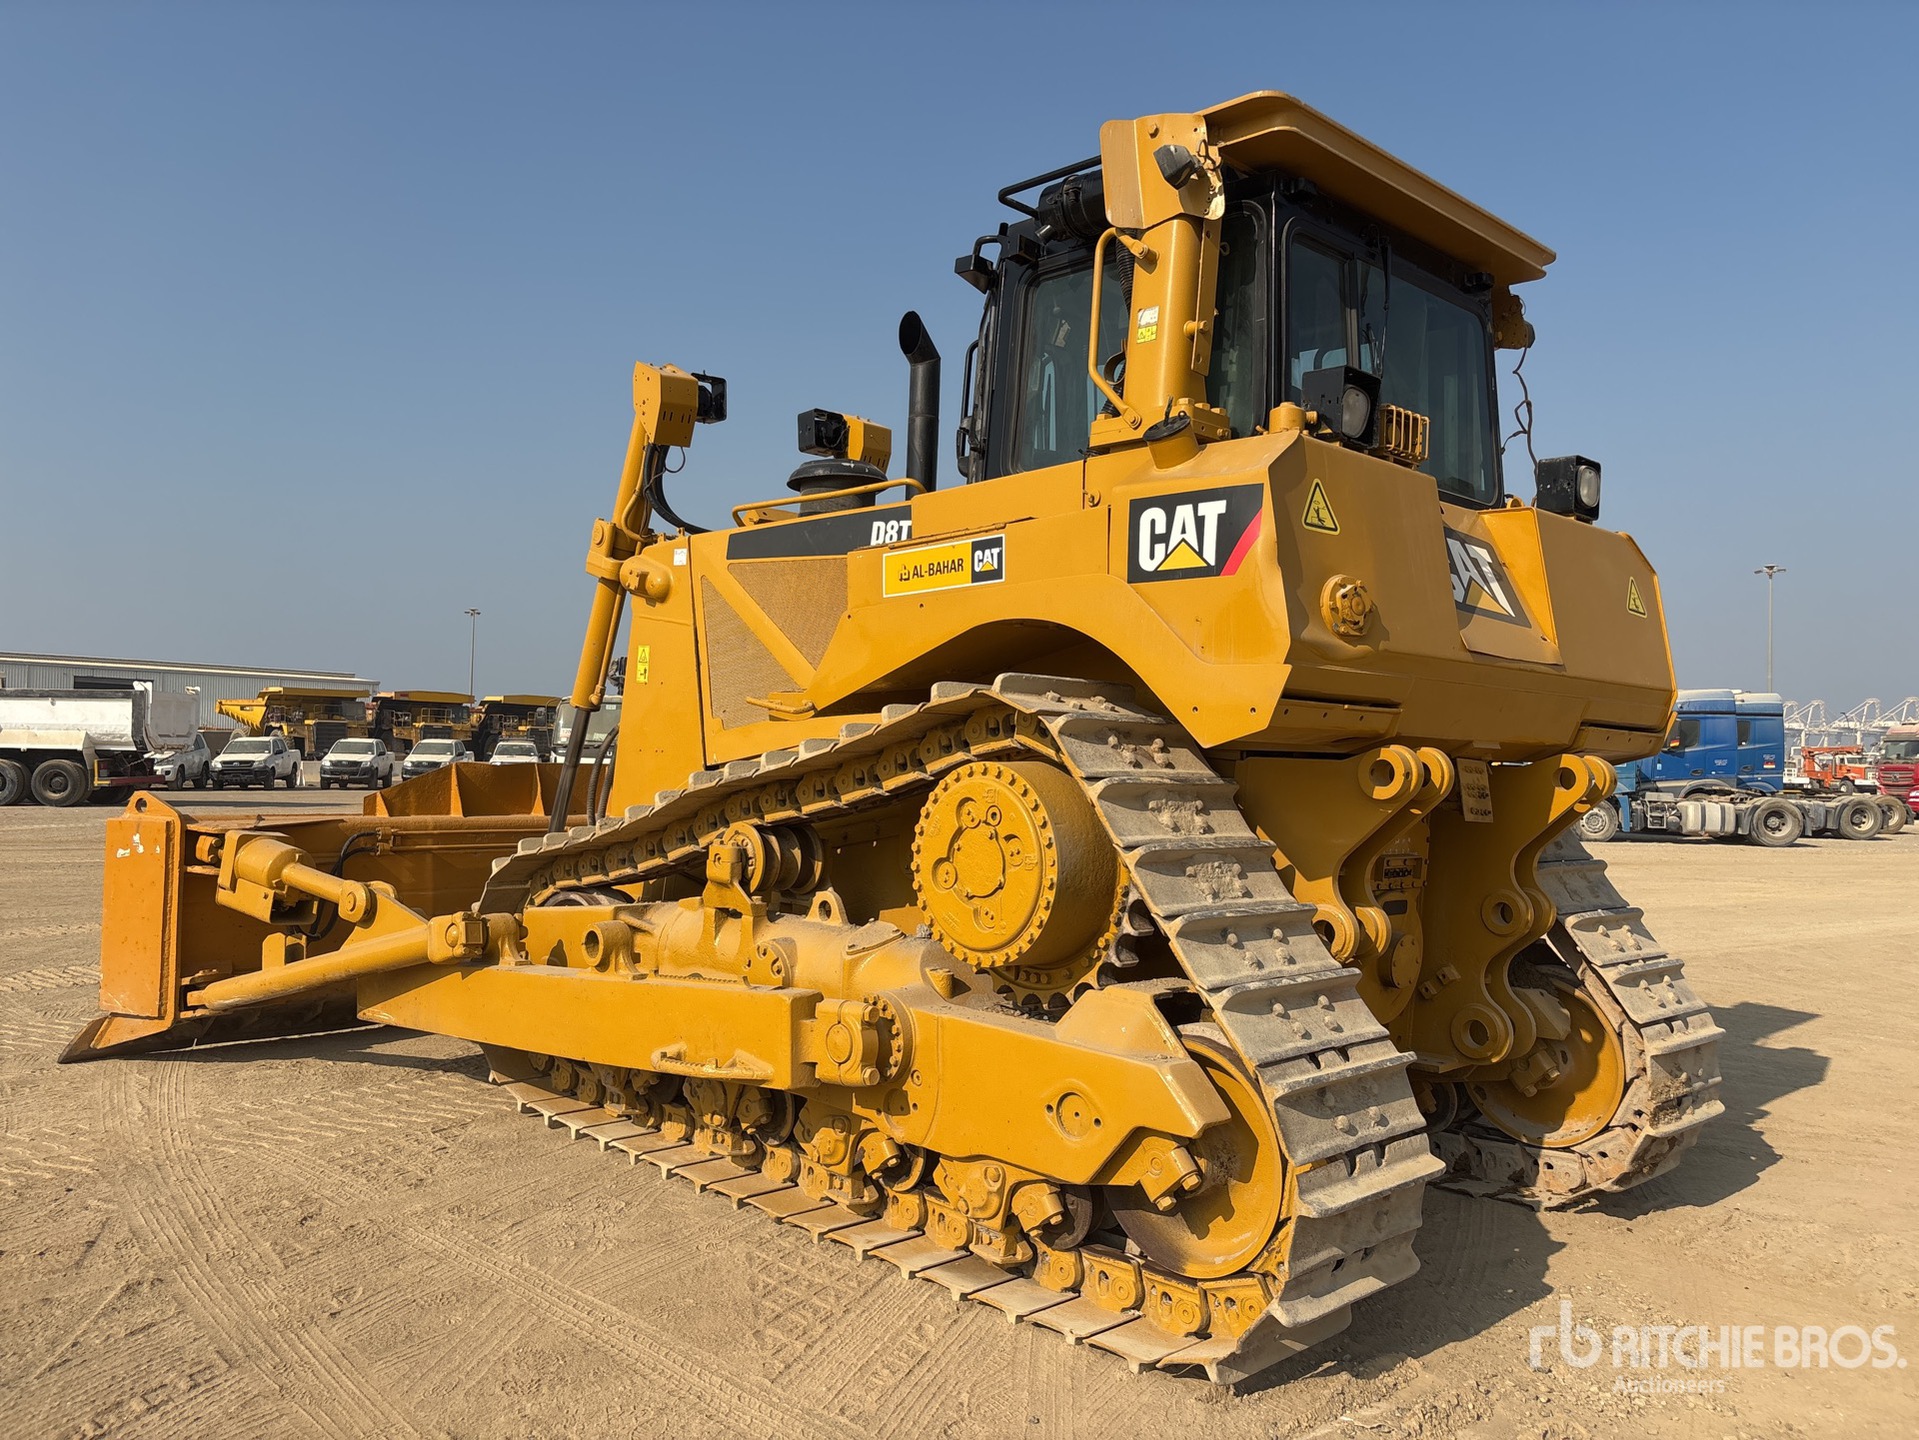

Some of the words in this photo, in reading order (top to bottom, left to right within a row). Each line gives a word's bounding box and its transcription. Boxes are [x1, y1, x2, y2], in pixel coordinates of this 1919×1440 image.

[871, 520, 912, 546] D8T
[1138, 500, 1226, 572] CAT
[912, 558, 964, 579] AL-BAHAR
[974, 547, 1001, 572] CAT
[1446, 538, 1516, 618] AT
